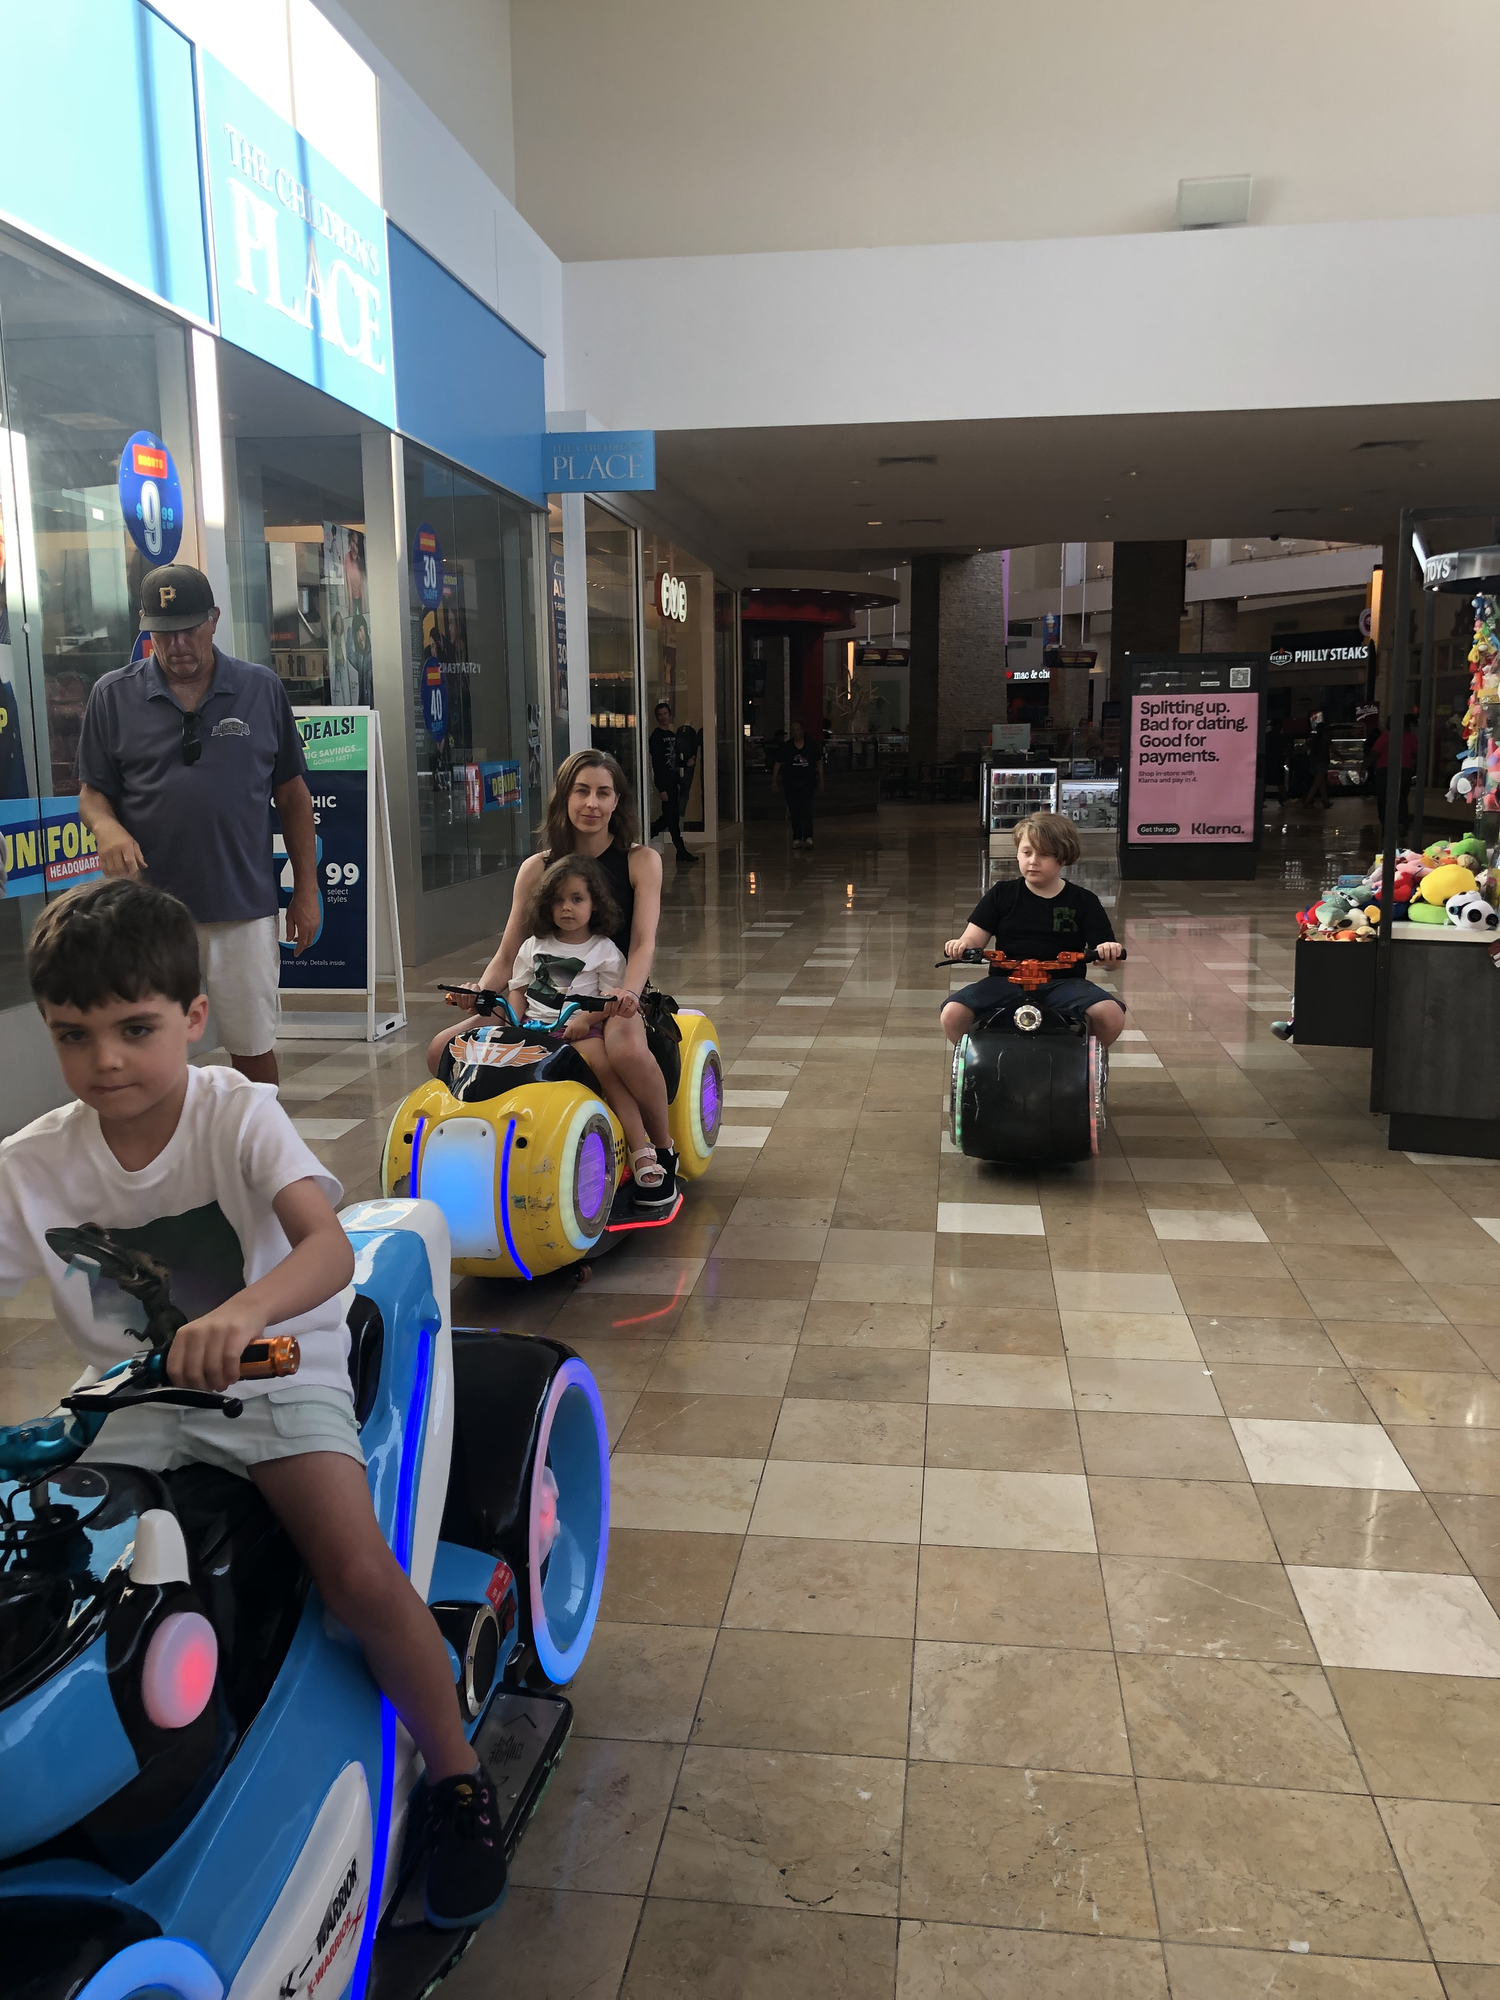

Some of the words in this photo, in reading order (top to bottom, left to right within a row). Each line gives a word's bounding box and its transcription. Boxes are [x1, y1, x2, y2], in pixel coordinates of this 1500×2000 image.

[223, 122, 273, 192] THE
[274, 167, 380, 277] CHILDREN'S
[227, 176, 386, 376] PLACE
[552, 443, 572, 453] THE
[137, 453, 164, 470] SHORTS
[552, 453, 645, 481] PLACE
[424, 555, 437, 590] 30
[1427, 558, 1451, 583] TOYS
[159, 585, 176, 609] P
[1295, 648, 1330, 662] PHILLY
[1330, 646, 1368, 660] STEAKS
[1013, 671, 1030, 680] mac
[1030, 669, 1038, 679] &
[431, 688, 443, 721] 40
[1140, 699, 1204, 717] Splitting
[1206, 702, 1230, 716] up.
[304, 716, 355, 740] DEALS!
[1140, 717, 1169, 731] Bad
[1171, 716, 1194, 730] for
[1196, 715, 1248, 732] dating.
[1140, 733, 1182, 748] Good
[1184, 733, 1207, 747] for
[313, 757, 334, 766] GOING
[335, 754, 352, 763] FAST!
[1139, 749, 1220, 766] payments.
[1138, 770, 1155, 778] Shop
[1138, 777, 1158, 785] Klarna
[1172, 777, 1183, 785] pay
[325, 862, 360, 886] 99
[327, 887, 349, 895] select
[327, 895, 348, 903] styles
